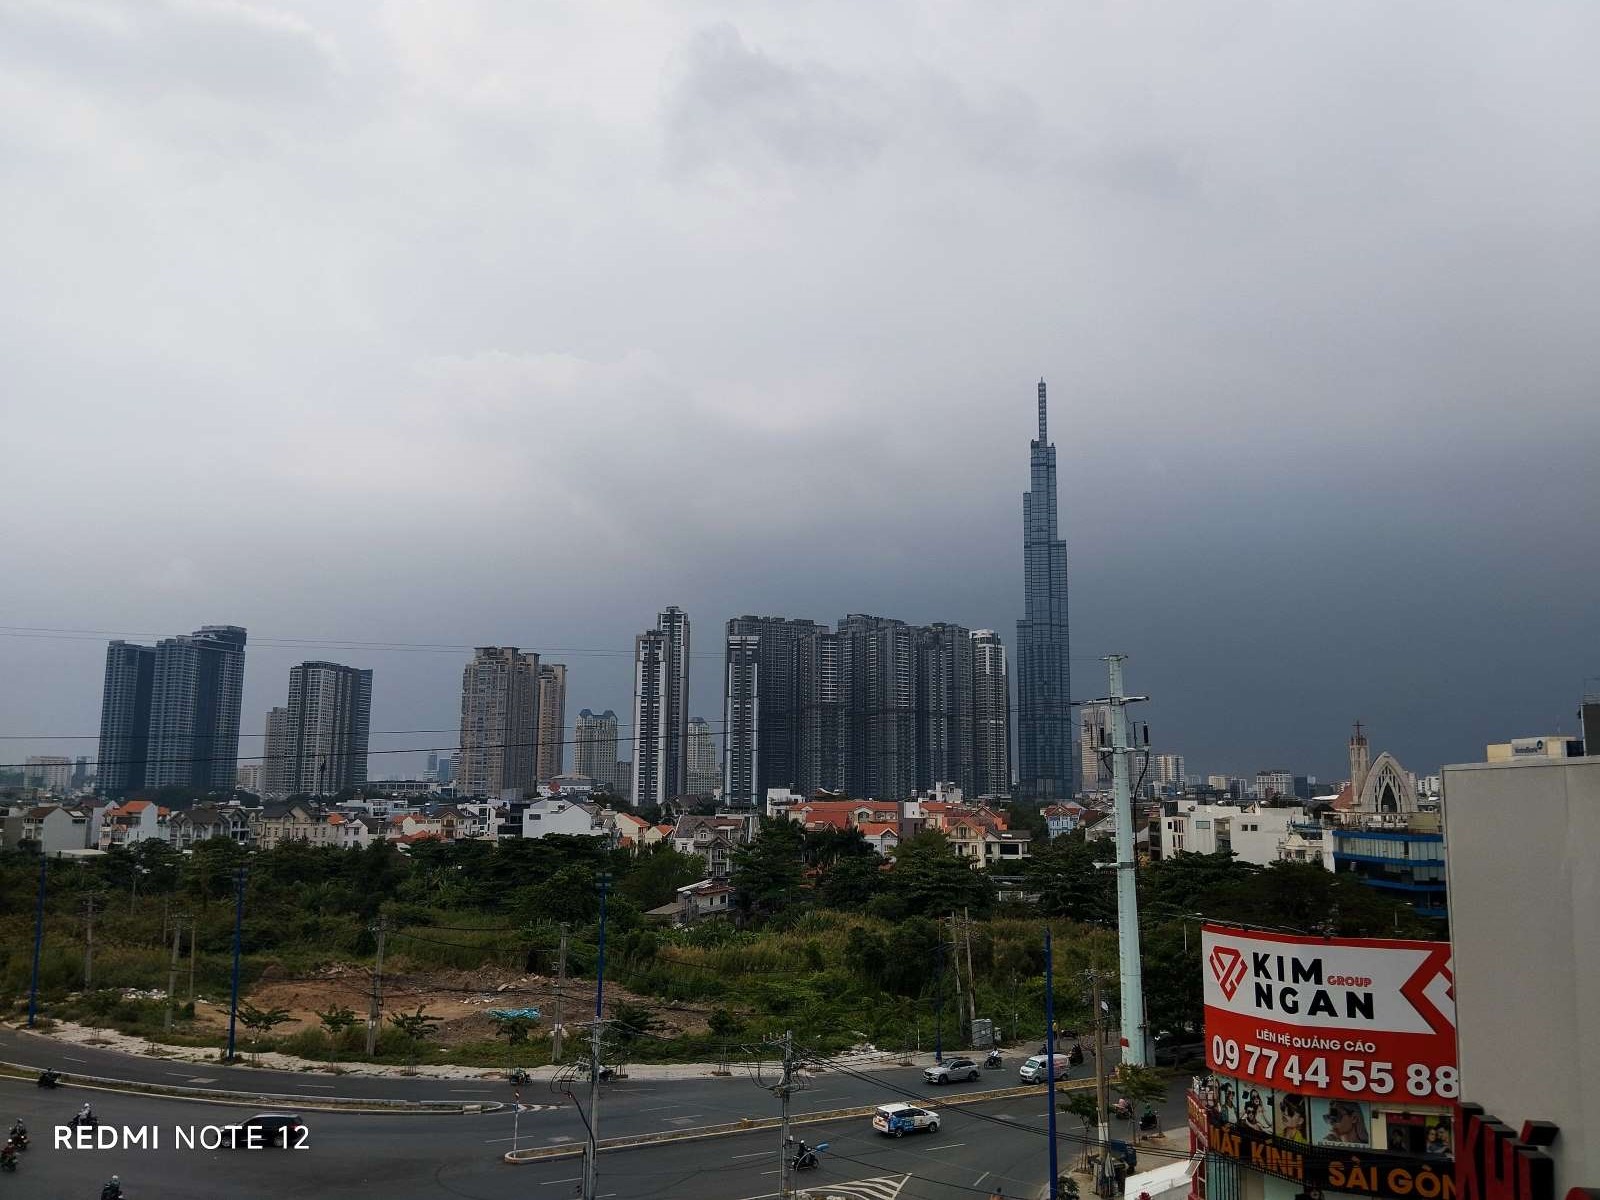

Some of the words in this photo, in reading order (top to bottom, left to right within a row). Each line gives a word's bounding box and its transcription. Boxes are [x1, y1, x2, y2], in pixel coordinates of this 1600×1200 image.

[1252, 952, 1323, 985] KIM
[1327, 975, 1372, 987] GROUP
[1255, 982, 1374, 1019] NGAN
[1256, 1029, 1276, 1043] LIÊN
[1277, 1033, 1291, 1047] HỆ
[1292, 1036, 1341, 1050] QUẢNG
[1344, 1039, 1376, 1053] CÁO
[1341, 1060, 1394, 1094] 55
[1406, 1064, 1458, 1098] 88
[1250, 1138, 1303, 1181] KÍNH
[1328, 1155, 1378, 1192] SÀI
